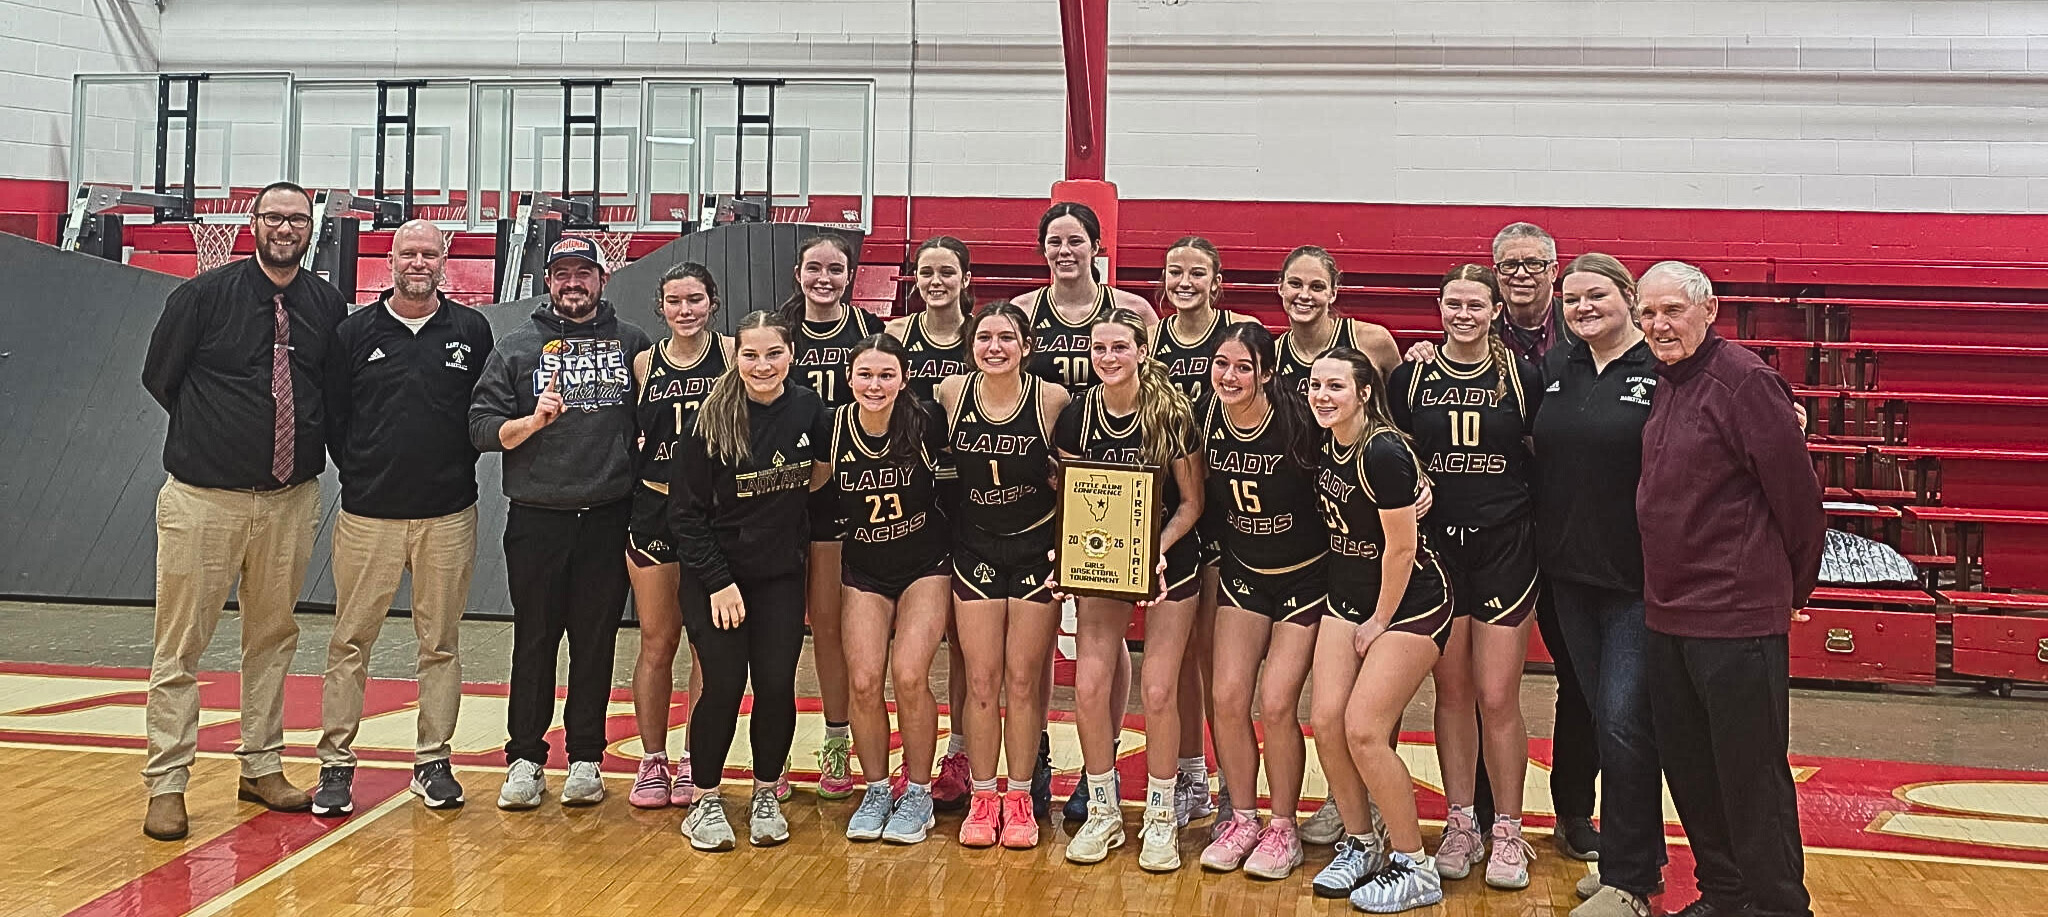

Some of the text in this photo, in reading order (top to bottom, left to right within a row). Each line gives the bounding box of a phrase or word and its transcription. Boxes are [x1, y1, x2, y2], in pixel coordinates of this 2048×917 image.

[1034, 335, 1091, 353] LAD
[543, 351, 622, 372] STATE
[795, 348, 854, 366] ADY
[1169, 356, 1212, 377] AD
[907, 359, 967, 378] LAD
[1053, 356, 1089, 386] 30
[808, 369, 835, 401] 31
[1421, 387, 1507, 408] LADY
[1448, 410, 1480, 446] 10
[956, 431, 1038, 455] LADY
[1209, 448, 1284, 475] LADY
[1427, 452, 1507, 474] ACES
[840, 465, 915, 491] LADY
[989, 460, 1002, 486] 1
[970, 485, 1037, 504] ACES
[1073, 487, 1122, 497] CONFERENCE
[1074, 481, 1099, 489] LITTLE
[1229, 478, 1262, 513] 15
[1319, 468, 1356, 503] ADY
[865, 493, 903, 523] 23
[855, 511, 926, 542] ACES
[1131, 480, 1143, 585] FIRST PLACE
[1226, 509, 1293, 535] ACES
[1068, 534, 1079, 544] 20
[1114, 538, 1124, 549] 26
[1330, 533, 1379, 560] CES
[1070, 567, 1119, 577] BASKETBALL
[1084, 561, 1105, 569] GIRLS
[1069, 574, 1120, 584] TOURNAMENT
